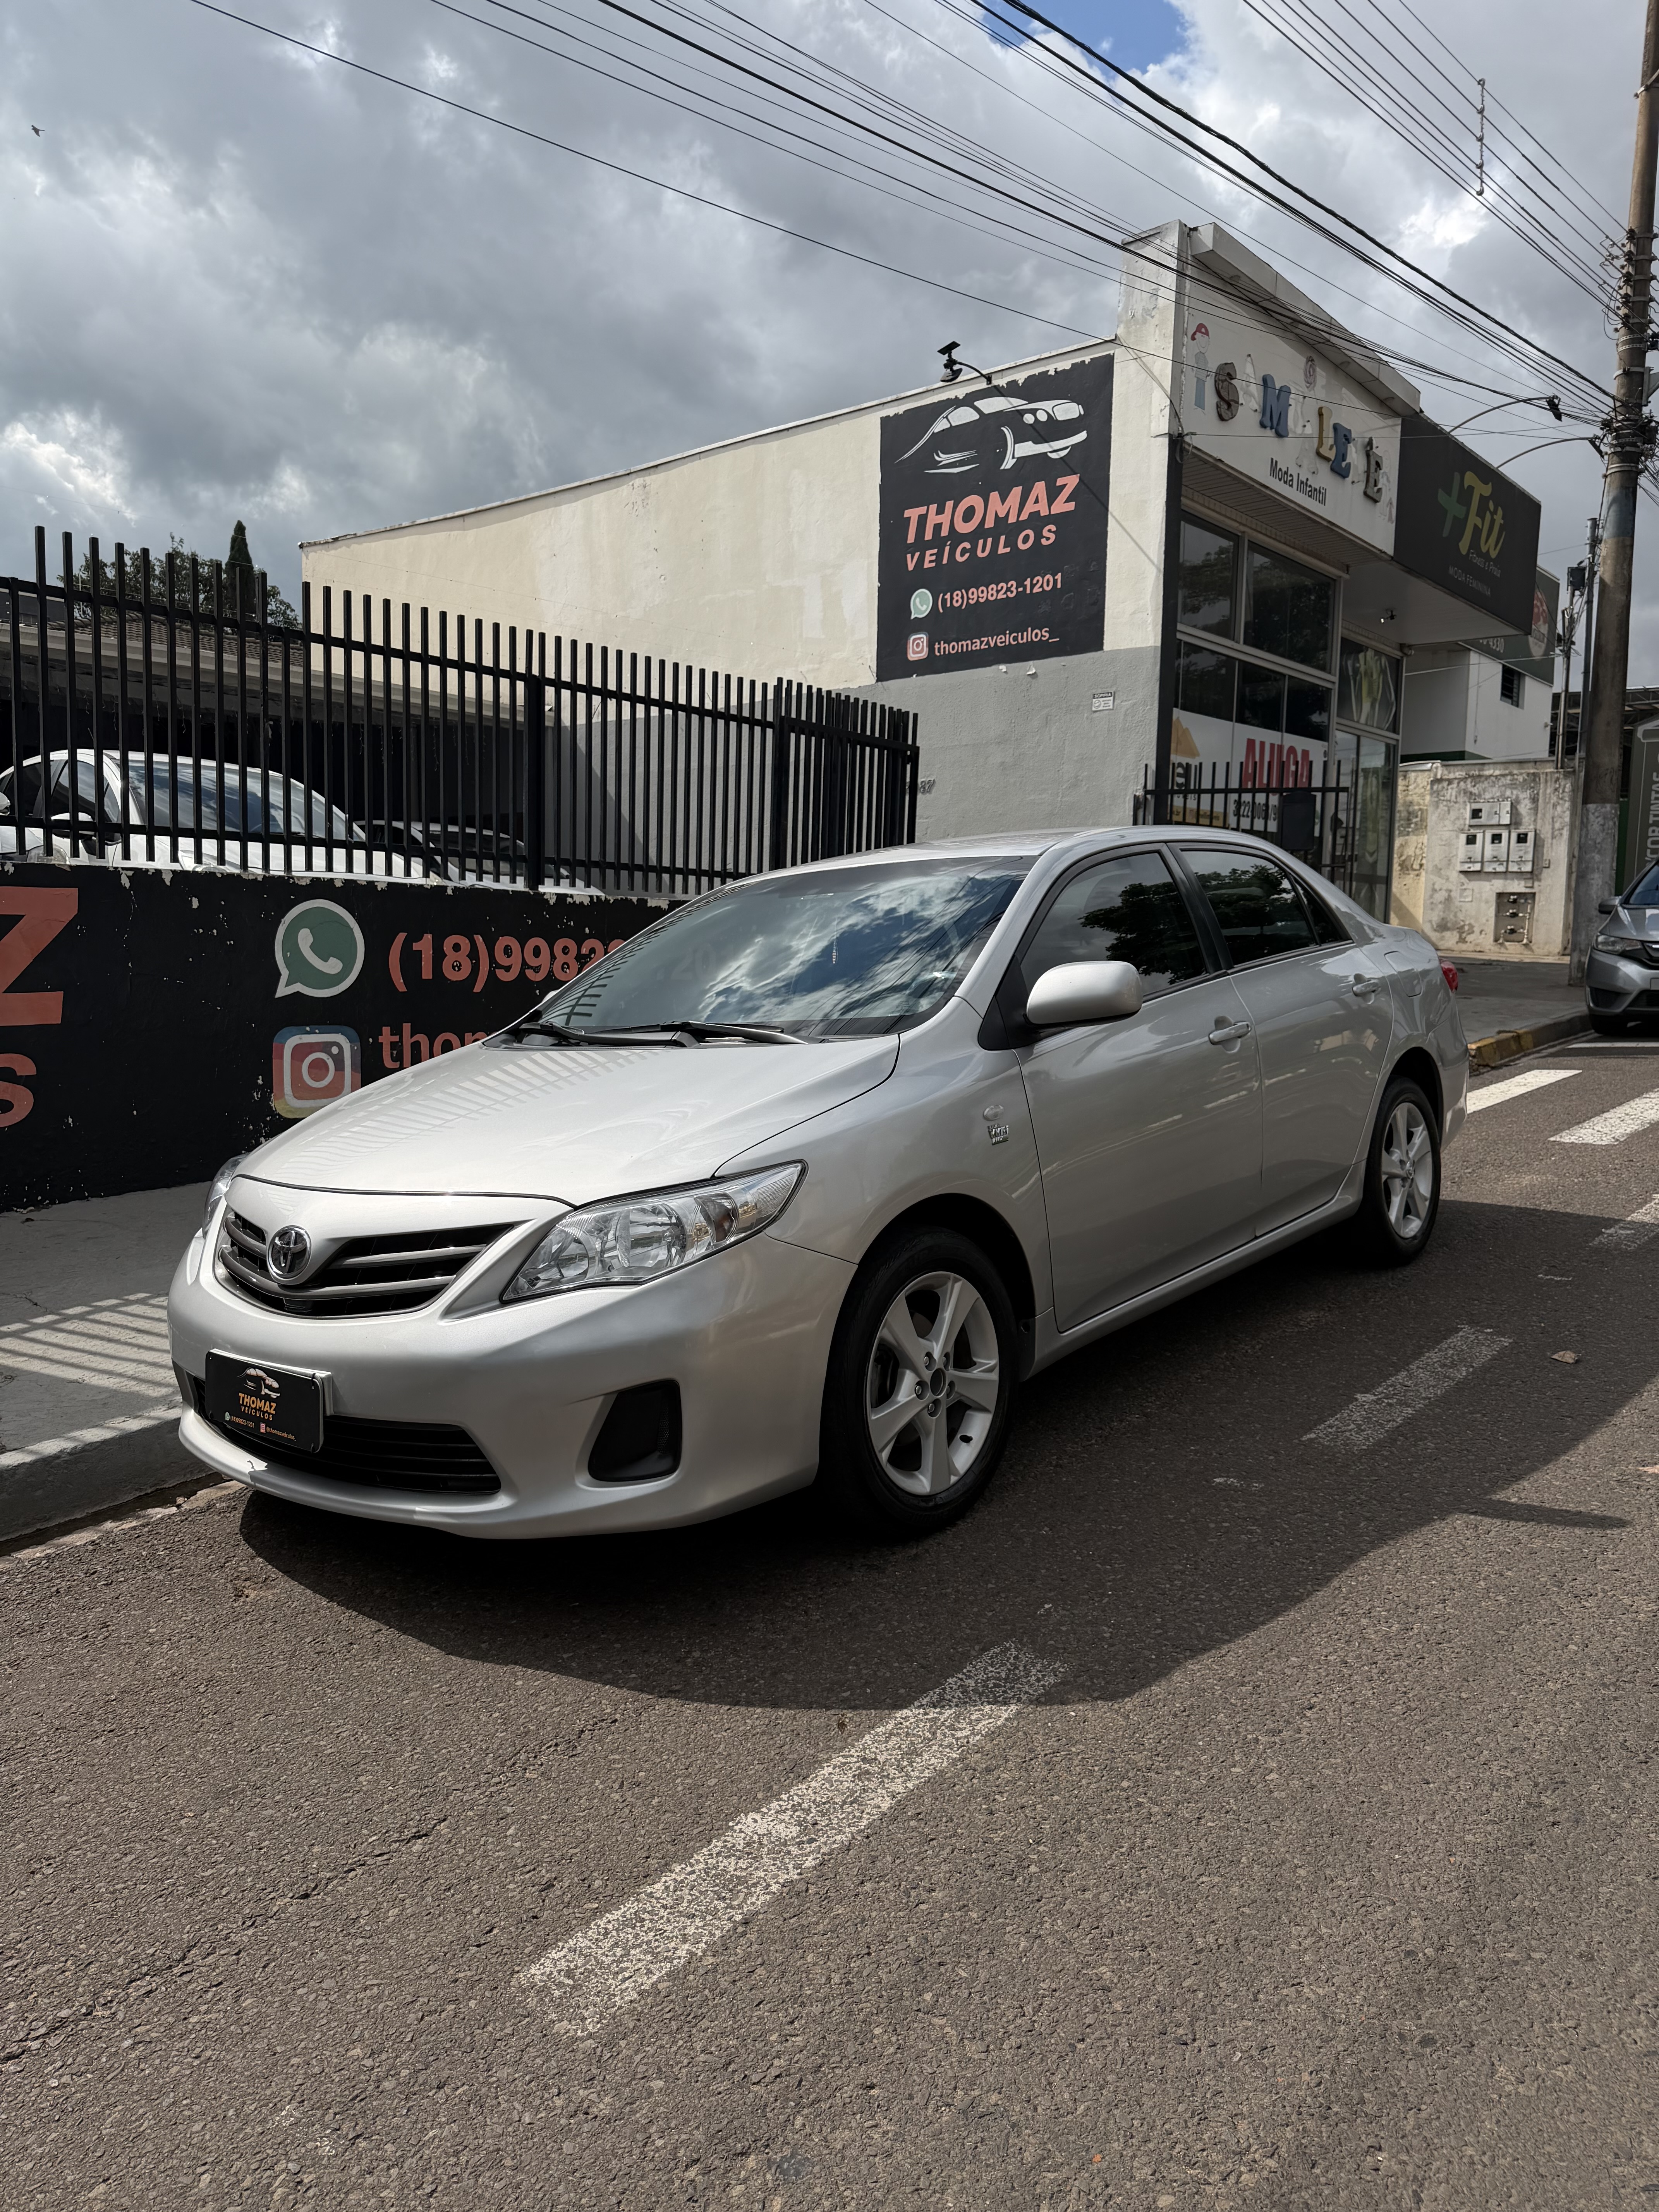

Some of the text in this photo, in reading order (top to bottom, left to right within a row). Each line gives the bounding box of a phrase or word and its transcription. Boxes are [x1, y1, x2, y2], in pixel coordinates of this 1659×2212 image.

[1269, 457, 1327, 506] Moda Infantil
[903, 474, 1080, 544] THOMAZ
[906, 524, 1057, 571] VEÍCULOS
[938, 572, 1061, 613] (18)99823-1201
[1448, 564, 1465, 583] MODA
[934, 627, 1060, 656] thomazveiculos_
[389, 932, 627, 992] (18)9982
[239, 1393, 276, 1414] THOMAZ
[241, 1405, 273, 1421] VEÍCULOS
